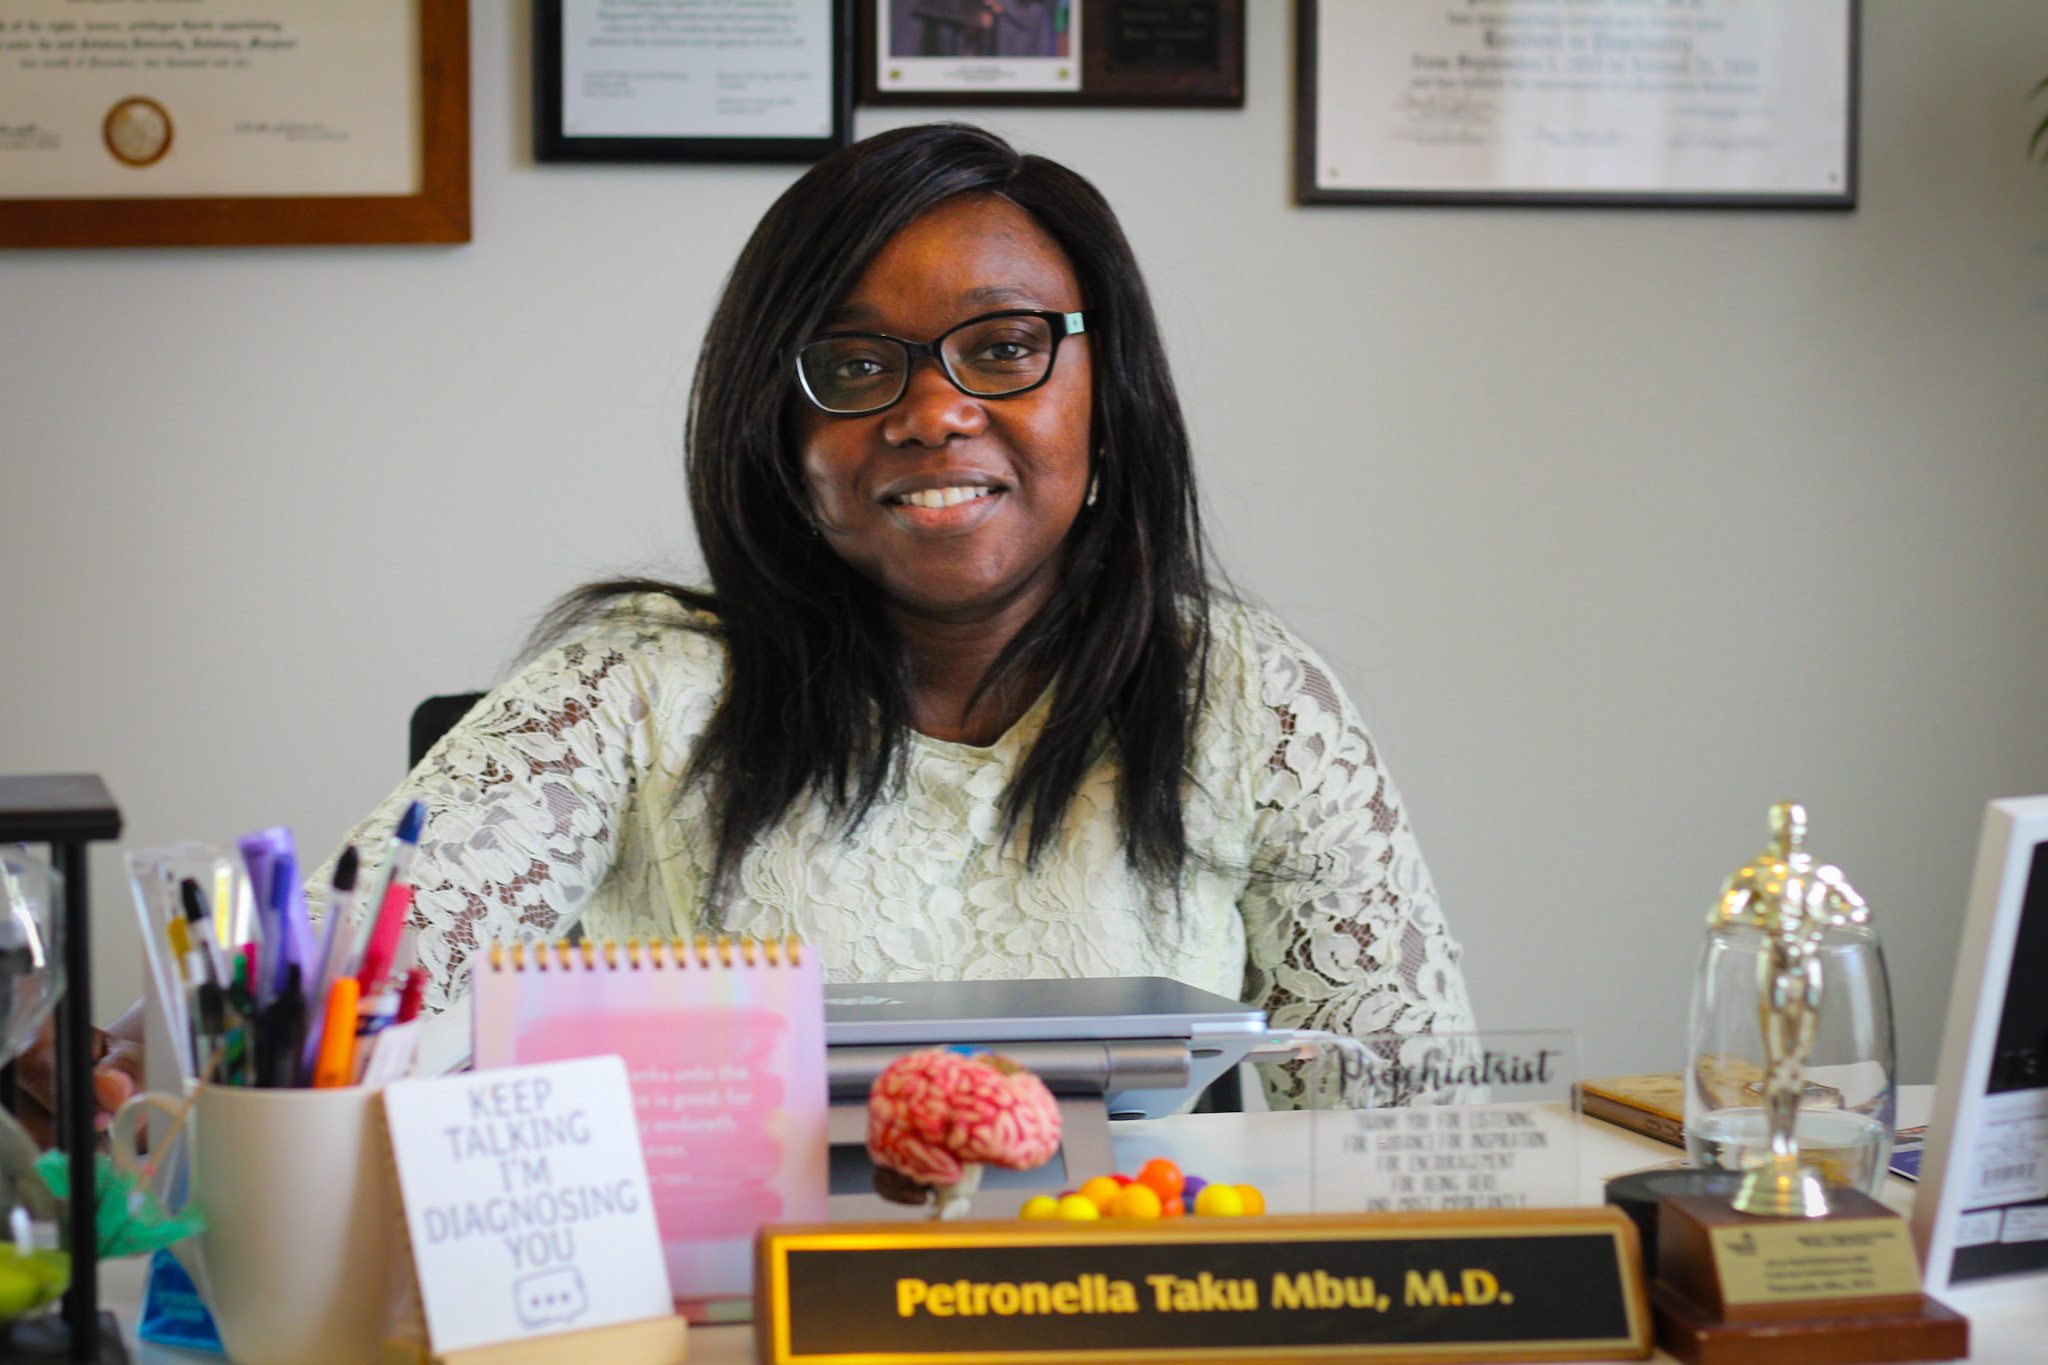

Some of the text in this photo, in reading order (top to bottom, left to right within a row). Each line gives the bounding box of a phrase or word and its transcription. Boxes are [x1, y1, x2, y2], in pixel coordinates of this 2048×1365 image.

[718, 1065, 749, 1081] the
[1337, 1045, 1560, 1097] Psychiatrist
[468, 1076, 552, 1120] KEEP
[444, 1110, 591, 1162] TALKING
[499, 1156, 552, 1194] I'M
[423, 1178, 640, 1246] DIAGNOSING
[503, 1228, 577, 1270] YOU
[896, 1268, 1514, 1317] Petronella Taku Mbu, M.D.
